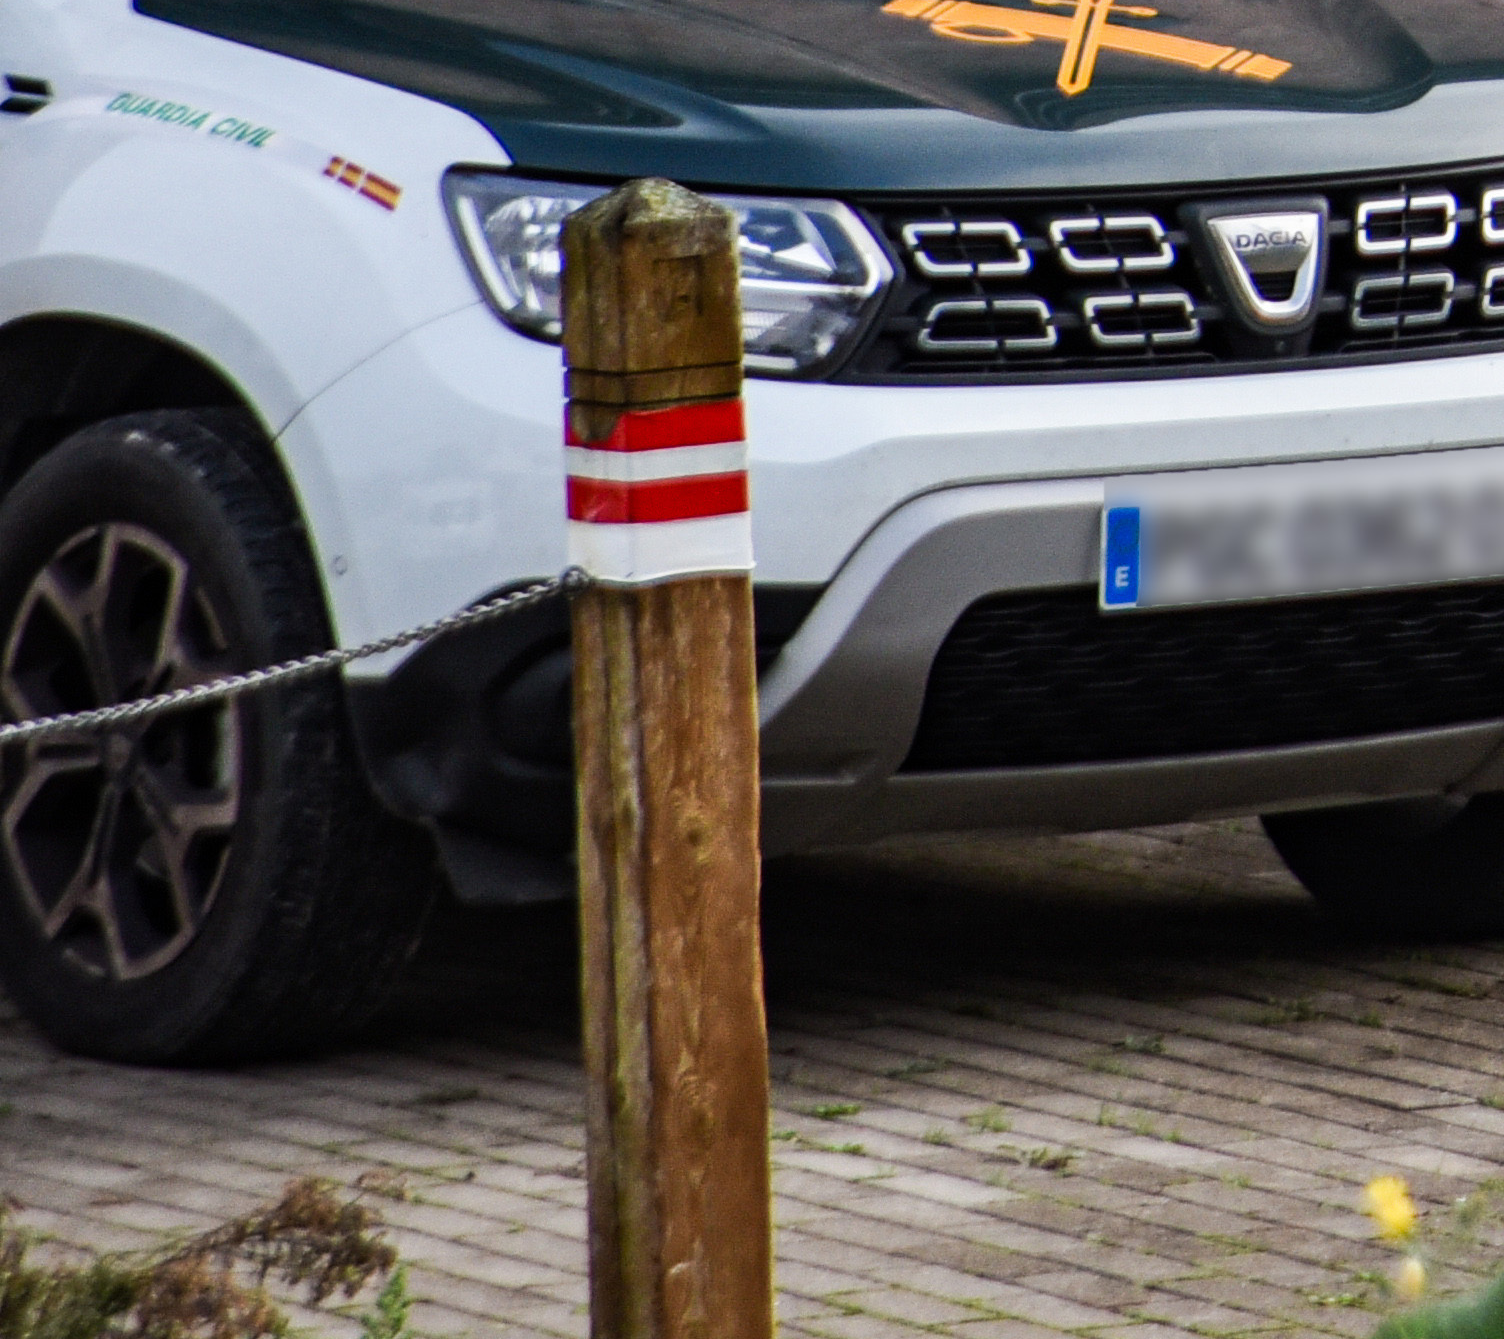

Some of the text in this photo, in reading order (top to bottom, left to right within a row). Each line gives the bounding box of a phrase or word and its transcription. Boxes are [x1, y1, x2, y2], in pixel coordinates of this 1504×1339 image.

[106, 93, 275, 148] GUARDIA CIVIL
[1235, 230, 1307, 249] DACIA
[1115, 565, 1130, 587] E
